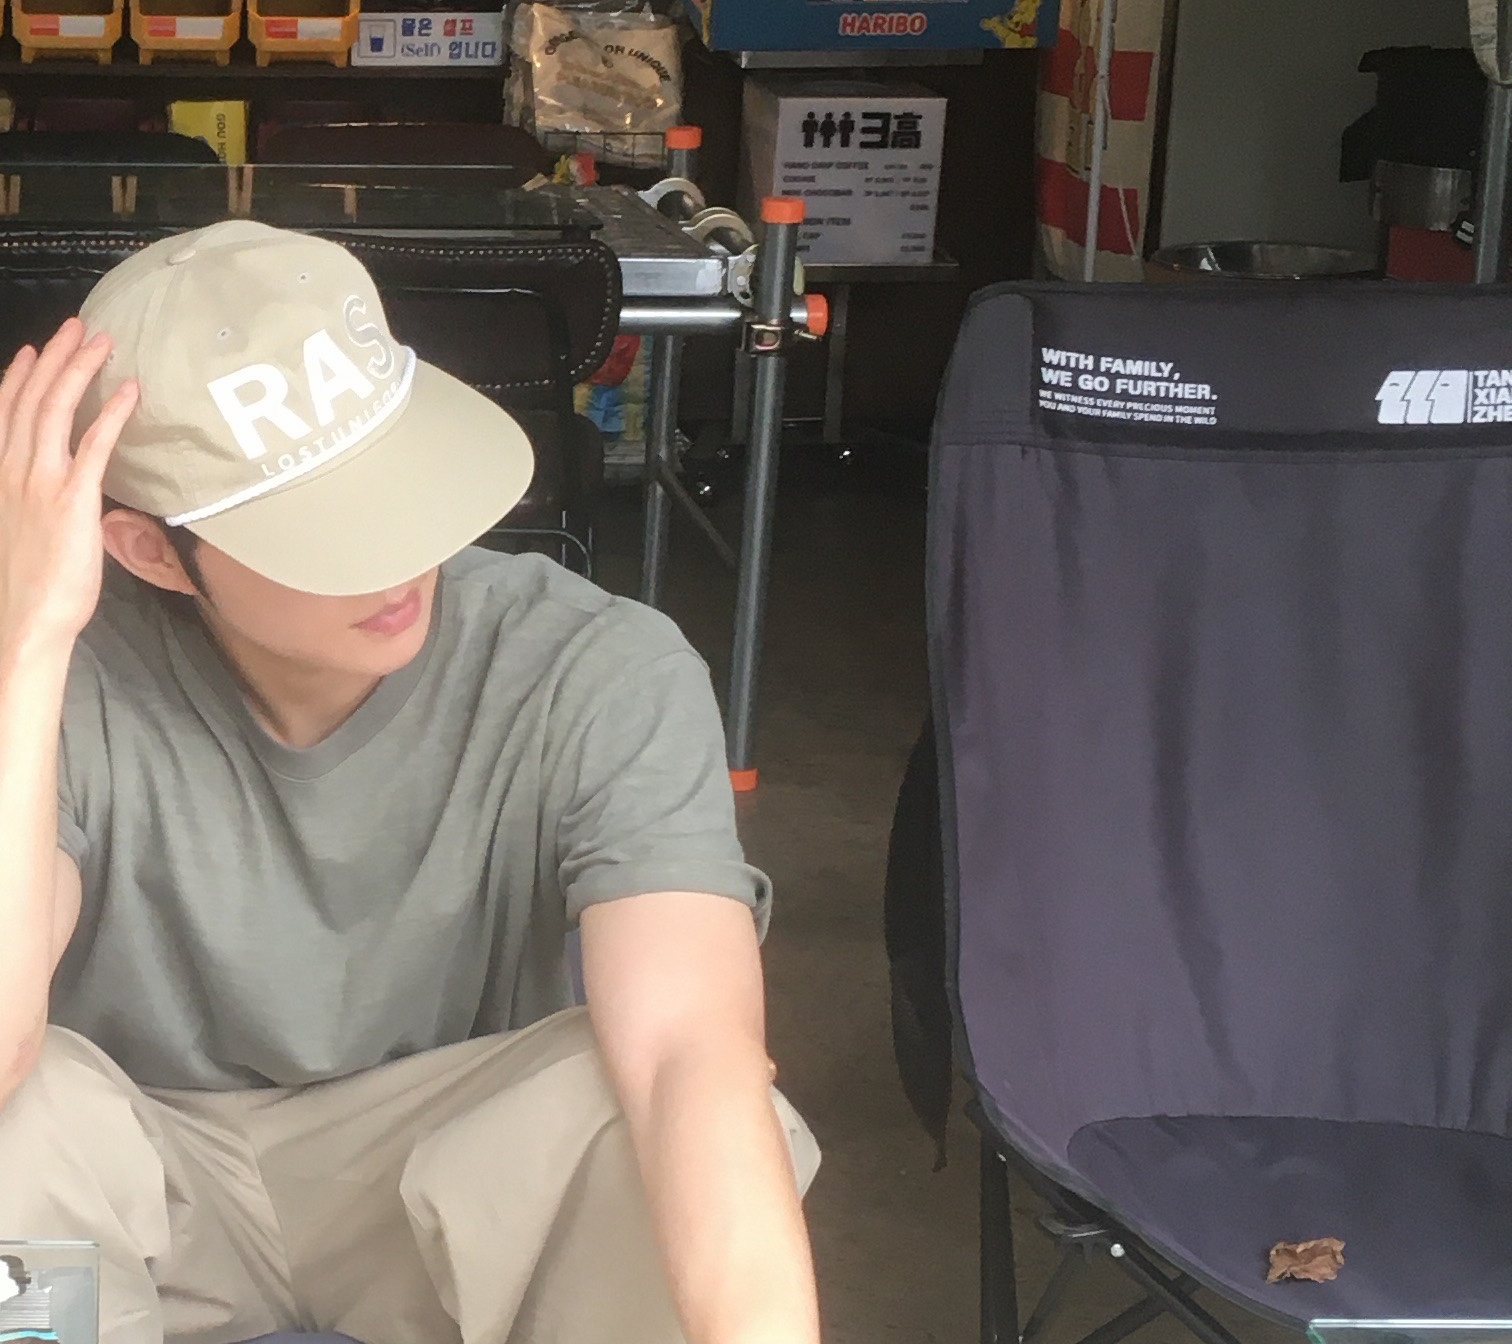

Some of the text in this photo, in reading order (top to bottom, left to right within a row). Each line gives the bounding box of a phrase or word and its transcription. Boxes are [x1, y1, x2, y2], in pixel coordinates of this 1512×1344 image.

[840, 12, 927, 36] HARIBO
[448, 40, 498, 60] 입니다
[1041, 347, 1181, 380] WITH FAMILY,
[1040, 367, 1218, 400] WE GO FURTHER.
[1038, 389, 1216, 415] WE WITNESS EVERY PRECIOUS MOMENT
[1038, 399, 1057, 410] YOU
[1056, 402, 1076, 413] AND
[1077, 405, 1102, 417] YOUR
[1101, 408, 1133, 420] FAMILY
[1133, 412, 1163, 423] SPEND
[1175, 415, 1193, 424] THE
[1194, 416, 1218, 425] WILD
